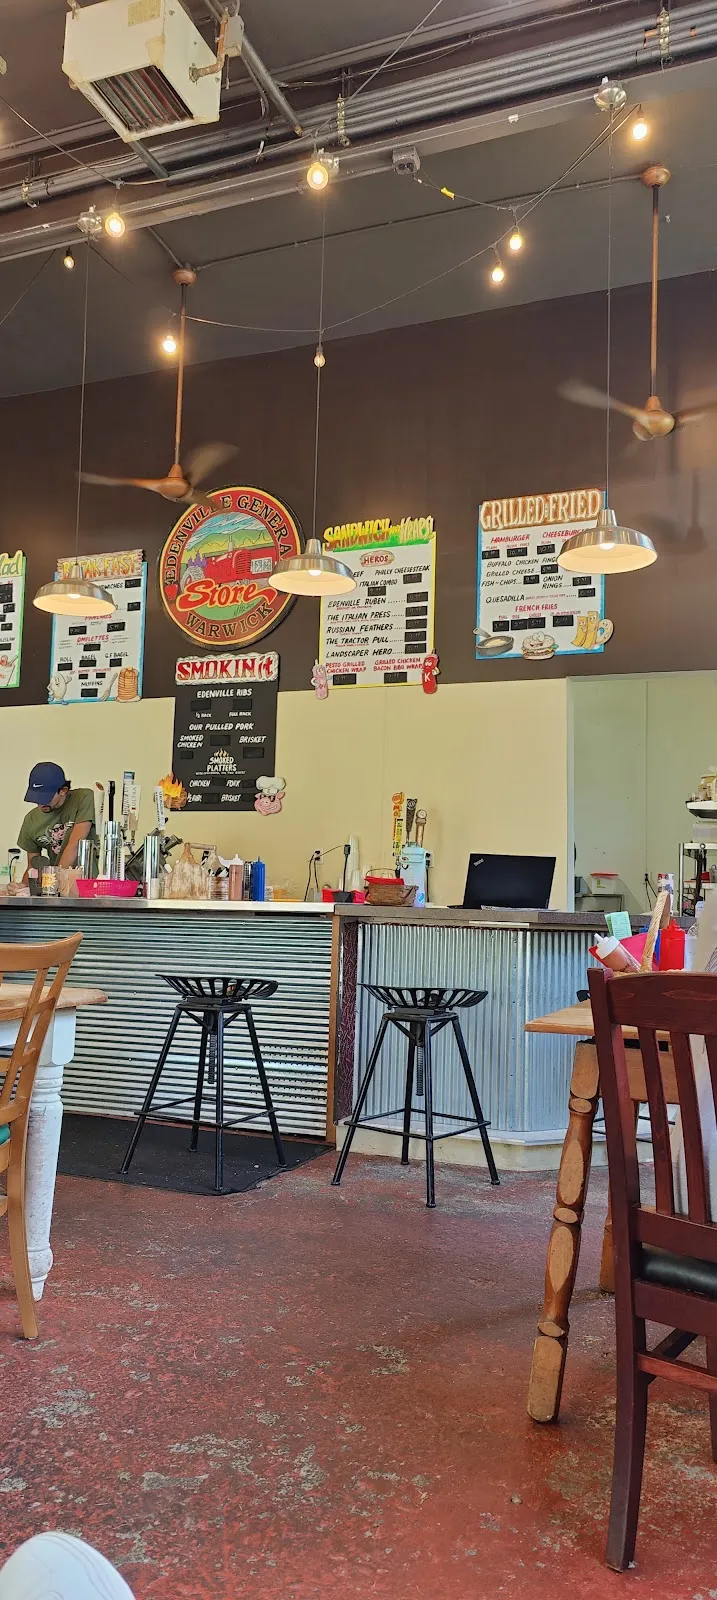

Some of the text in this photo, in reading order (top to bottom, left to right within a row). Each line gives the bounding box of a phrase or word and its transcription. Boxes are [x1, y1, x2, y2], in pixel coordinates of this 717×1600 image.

[481, 496, 545, 529] GRILLED
[548, 490, 600, 522] FRIED
[237, 495, 293, 558] GENERA
[323, 518, 391, 547] SANDWICH
[542, 528, 586, 538] CHEESEBUR
[491, 534, 530, 543] HAMBURGER
[0, 553, 20, 575] lad
[364, 555, 389, 565] HEROS
[62, 554, 136, 580] BAKFAST
[353, 570, 364, 578] EEF
[394, 565, 430, 573] CHEESESTEAK
[359, 580, 379, 588] ITALIAN
[499, 578, 516, 586] CHIPS
[176, 578, 278, 612] Store
[485, 595, 525, 604] QUESADILLA
[327, 599, 361, 608] EDENVILLE
[365, 597, 387, 606] RUBEN
[186, 602, 274, 638] WARWICK
[342, 612, 369, 620] ITALIAN
[370, 611, 391, 619] PRESS
[326, 626, 356, 634] RUSSIAN
[360, 623, 393, 631] FEATHERS
[326, 648, 392, 658] LANDSCAPER HERO
[425, 672, 431, 682] K
[197, 688, 253, 698] EDENVILLE RIBS
[189, 723, 203, 731] OUR
[235, 722, 254, 731] PORK
[209, 757, 234, 765] SMOKED
[207, 764, 237, 772] PLATTERS
